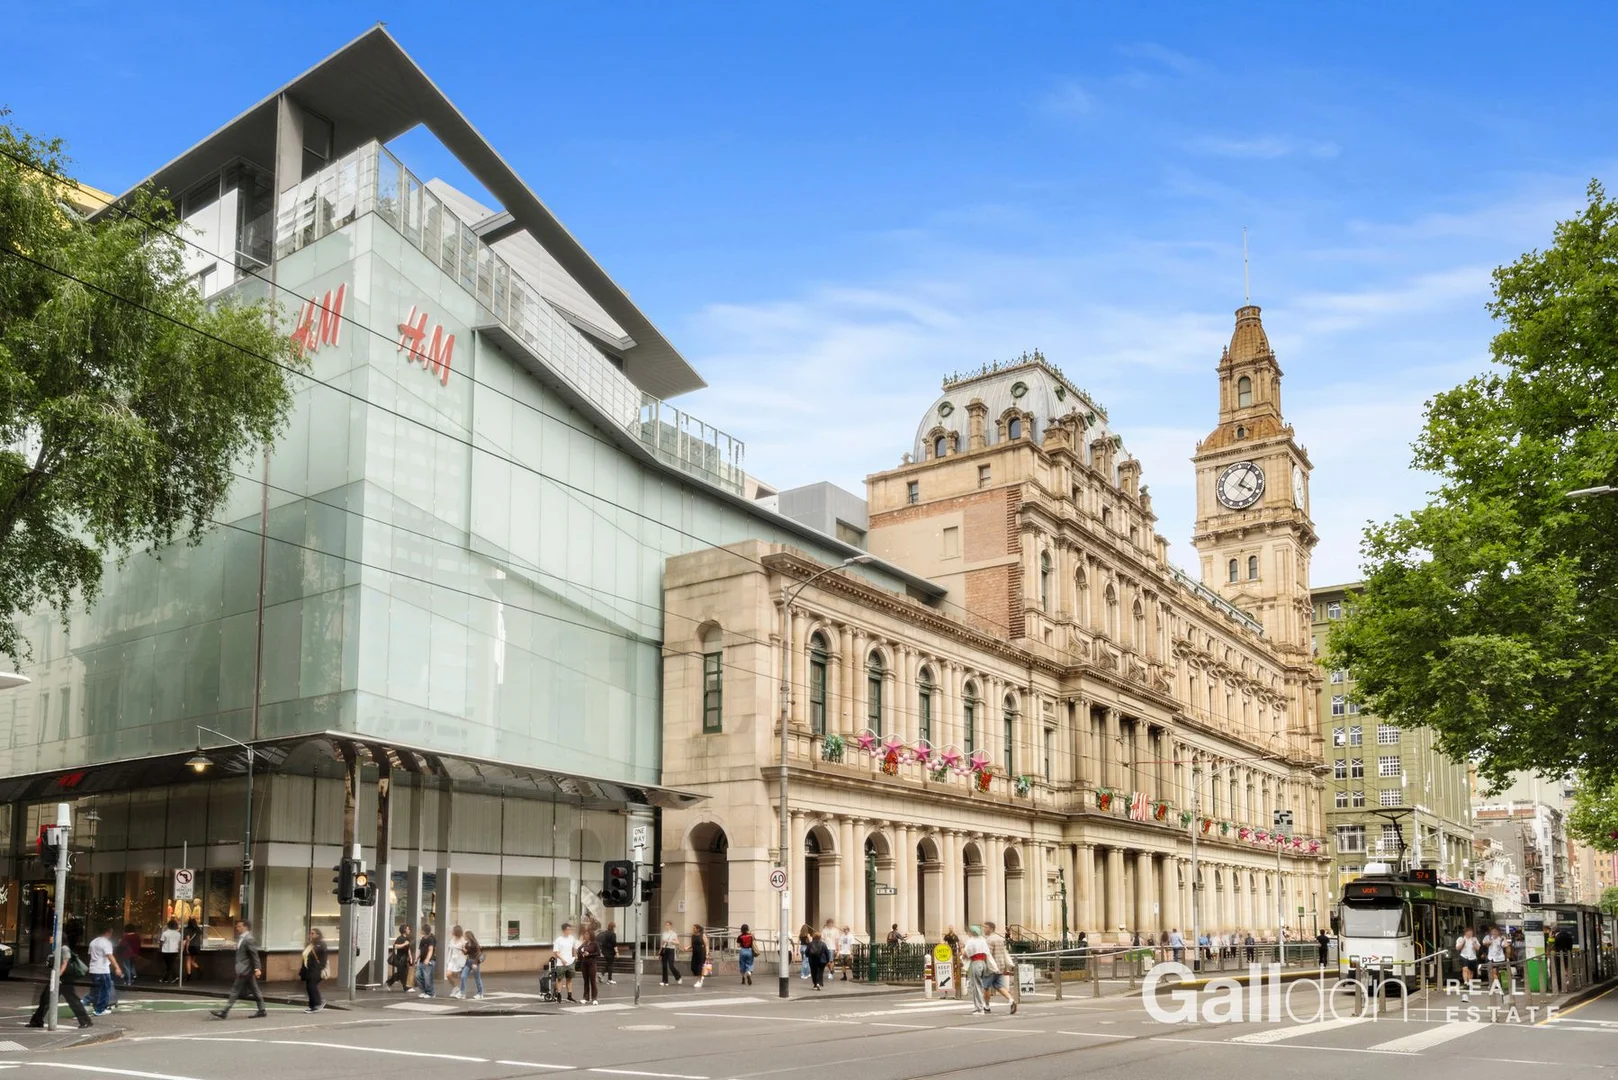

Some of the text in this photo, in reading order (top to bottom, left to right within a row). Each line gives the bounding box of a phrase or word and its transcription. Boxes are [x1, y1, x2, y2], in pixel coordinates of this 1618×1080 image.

[290, 282, 347, 360] H&M
[398, 304, 456, 387] H&M
[634, 827, 645, 835] ONE
[772, 874, 784, 884] 40
